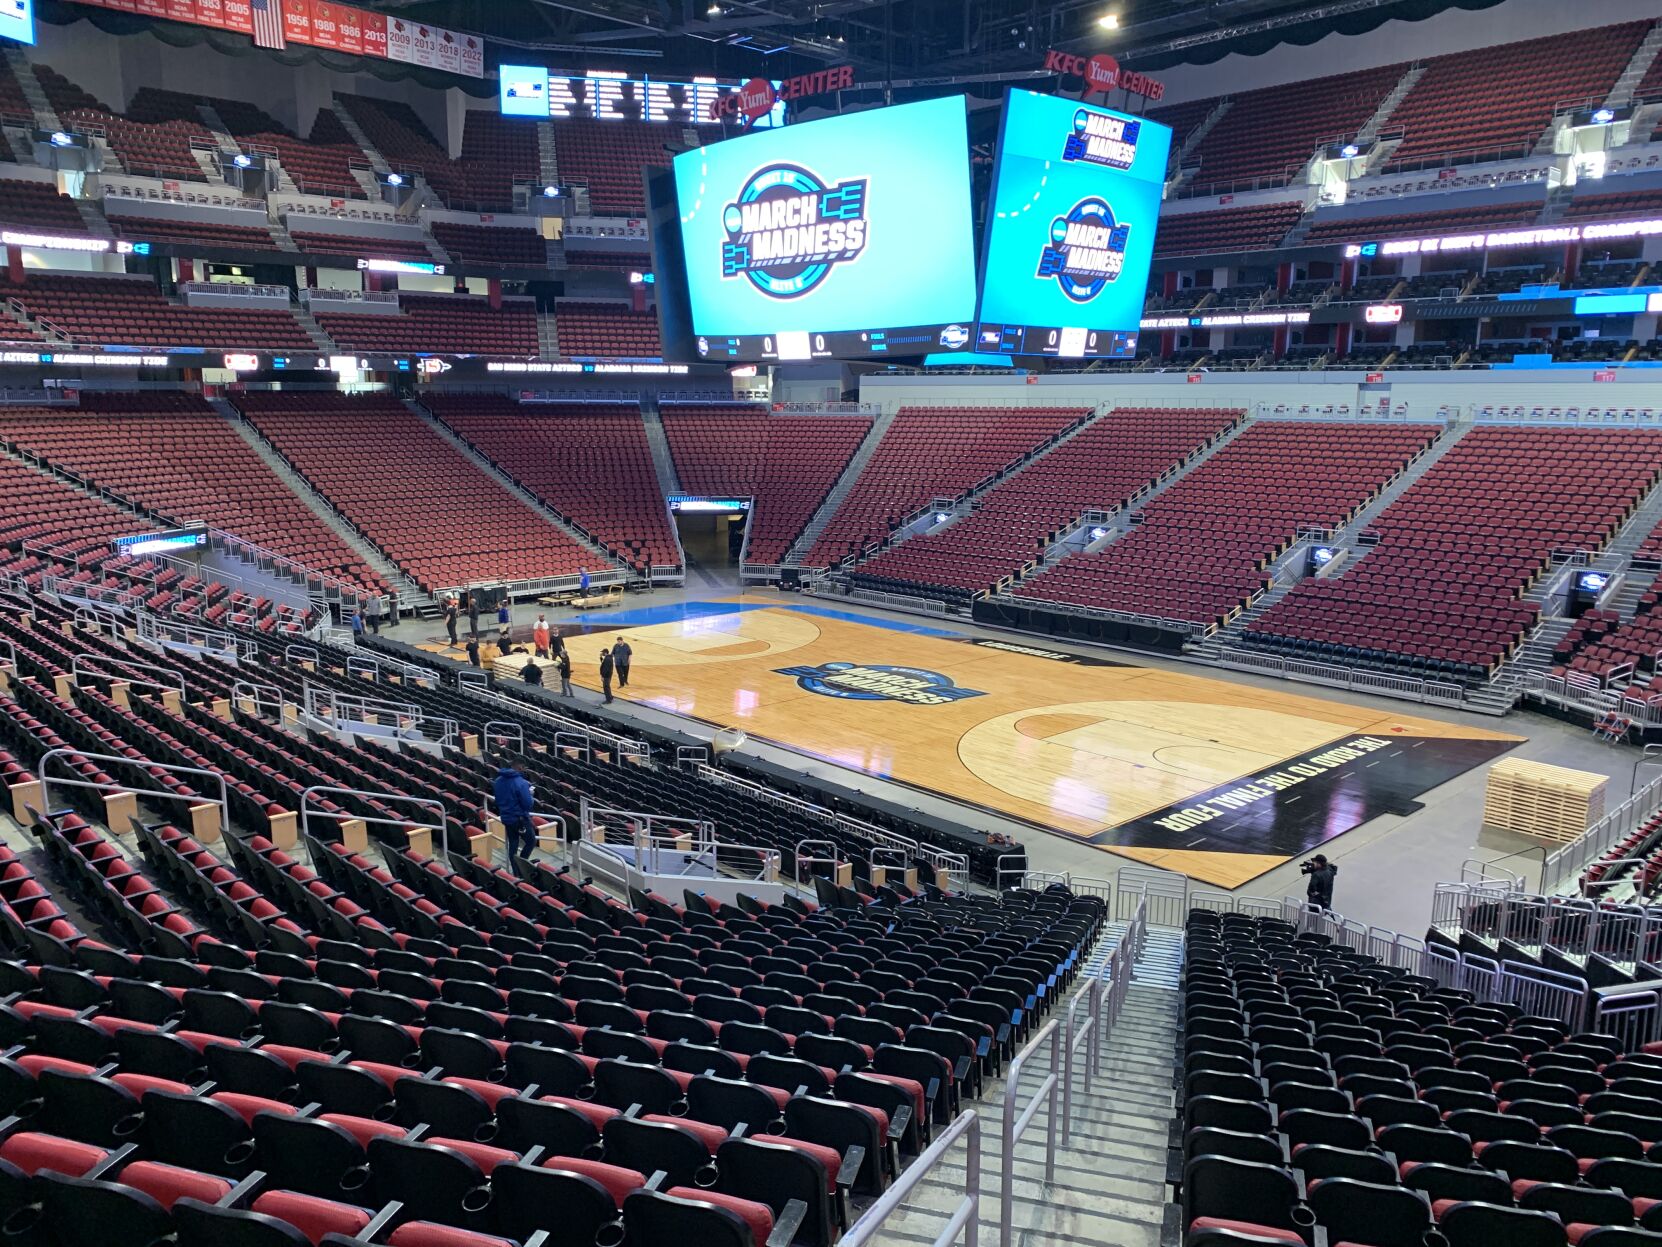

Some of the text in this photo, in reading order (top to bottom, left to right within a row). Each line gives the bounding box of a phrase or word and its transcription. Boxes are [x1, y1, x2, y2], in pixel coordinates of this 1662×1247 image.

[225, 1, 249, 15] 2005
[286, 14, 309, 26] 1956
[314, 19, 336, 32] 1980
[339, 24, 360, 38] 1986
[364, 29, 386, 42] 2013
[389, 31, 410, 45] 2009
[414, 37, 435, 51] 2013
[438, 43, 458, 56] 2018
[462, 48, 482, 61] 2022
[1046, 49, 1165, 101] KFC Yum! CENTER
[708, 94, 737, 121] KFC
[740, 85, 770, 110] Yum!
[780, 65, 854, 101] CENTER
[1085, 114, 1125, 140] MARCH
[1086, 135, 1136, 163] MADNESS
[741, 194, 818, 234] MARCH
[3, 232, 109, 252] CHAMPIONSHIP
[752, 219, 864, 261] MADNESS
[1064, 223, 1111, 249] MARCH
[1486, 227, 1580, 246] BASKETBALL
[1066, 246, 1124, 273] MADNESS
[1158, 318, 1189, 327] AZTECS
[1191, 318, 1200, 326] VS
[1201, 316, 1242, 325] ALABAMA
[1243, 314, 1286, 324] CRIMSON
[1287, 313, 1310, 322] TIDE
[764, 337, 772, 352] 0
[816, 334, 824, 351] 0
[1048, 330, 1097, 347] 0 0
[4, 352, 39, 362] AZTECS
[41, 354, 51, 362] VS
[53, 354, 93, 364] ALABAMA
[94, 356, 141, 364] CRIMSON
[143, 356, 168, 366] TIDE
[318, 358, 368, 368] 0 0
[595, 365, 632, 373] ALABAMA
[669, 366, 688, 374] TIDE
[977, 641, 1071, 659] LOUISVILLE
[839, 667, 937, 689] MARCH
[824, 674, 953, 704] MADNESS
[1153, 736, 1392, 832] THE ROAD TO THE FINAL FOUR
